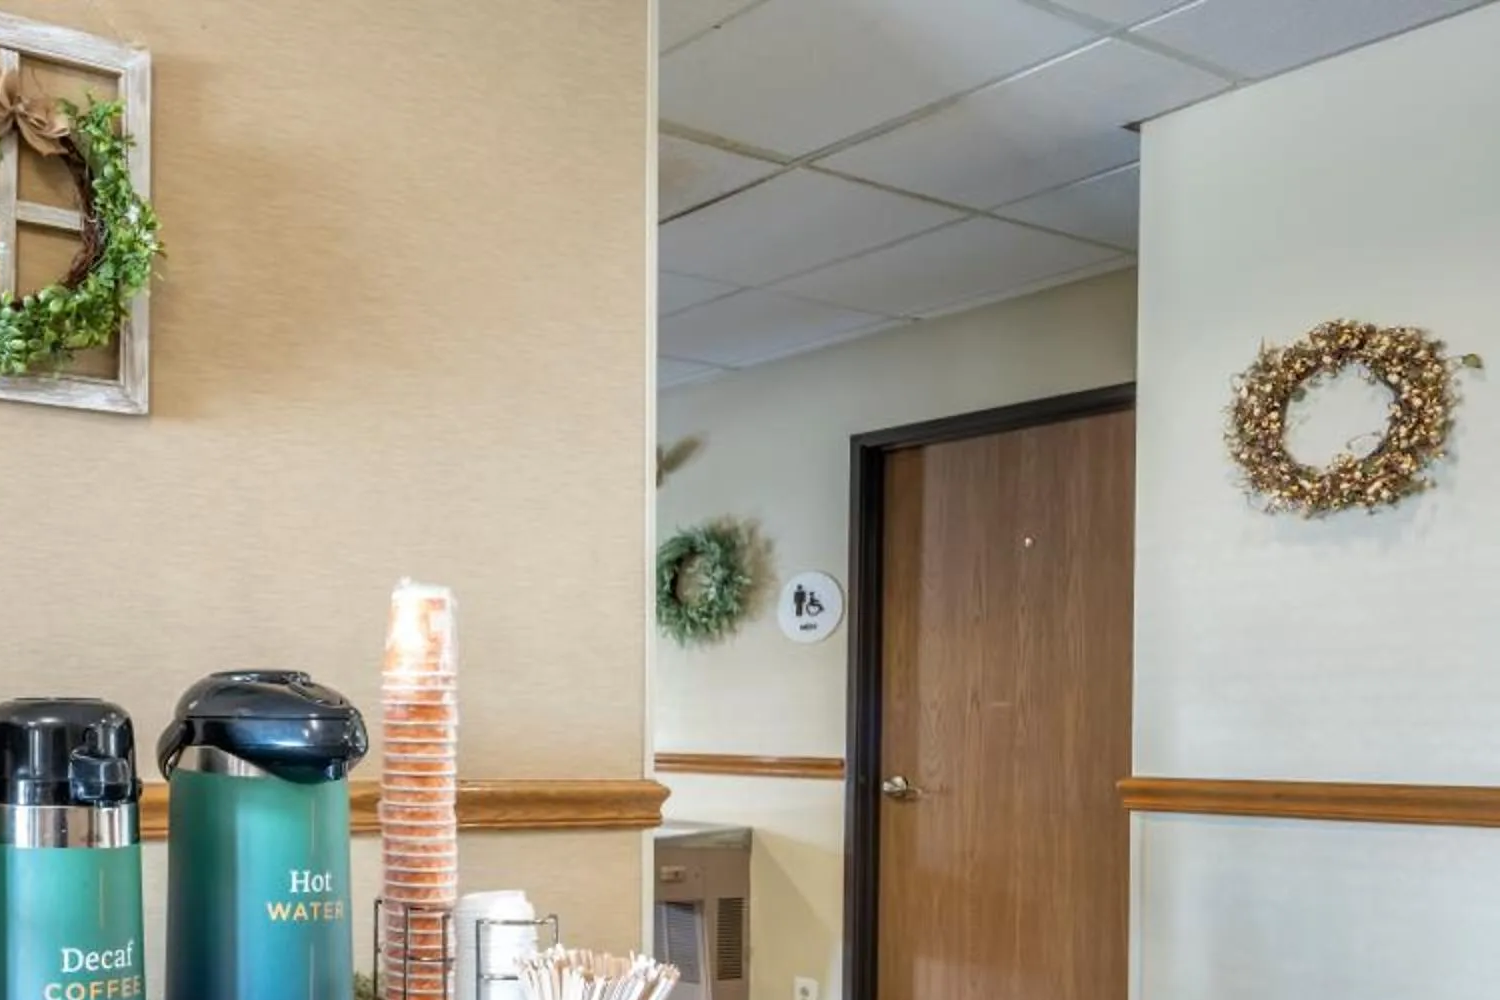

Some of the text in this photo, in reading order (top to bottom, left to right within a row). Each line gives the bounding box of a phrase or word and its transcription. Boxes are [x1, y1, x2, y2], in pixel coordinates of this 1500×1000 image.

[289, 869, 333, 893] Hot
[266, 899, 345, 921] WATER
[61, 938, 135, 973] Decaf
